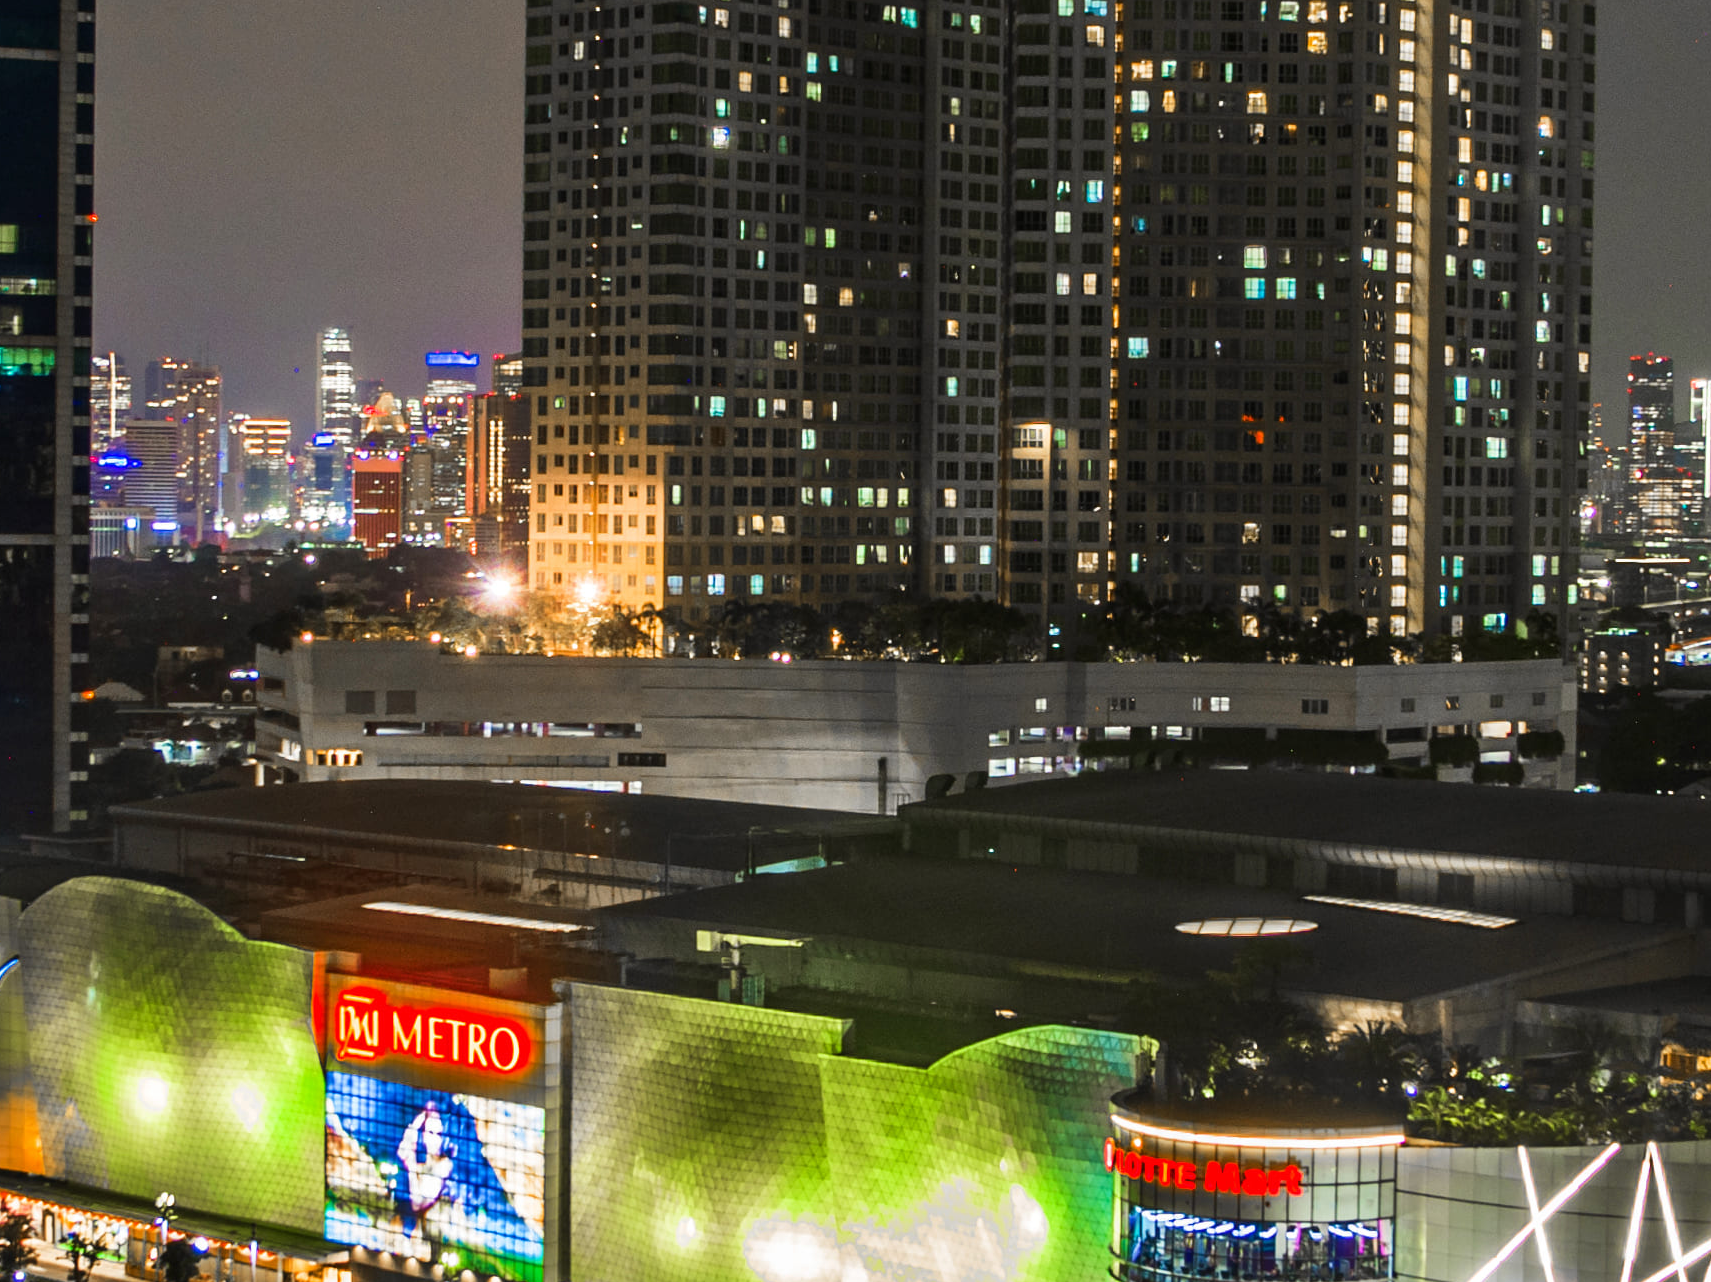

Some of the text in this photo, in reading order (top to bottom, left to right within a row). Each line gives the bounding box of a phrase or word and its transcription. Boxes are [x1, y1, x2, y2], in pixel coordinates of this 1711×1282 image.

[392, 1010, 521, 1072] METRO
[1114, 1147, 1305, 1197] LOTTE Mart
